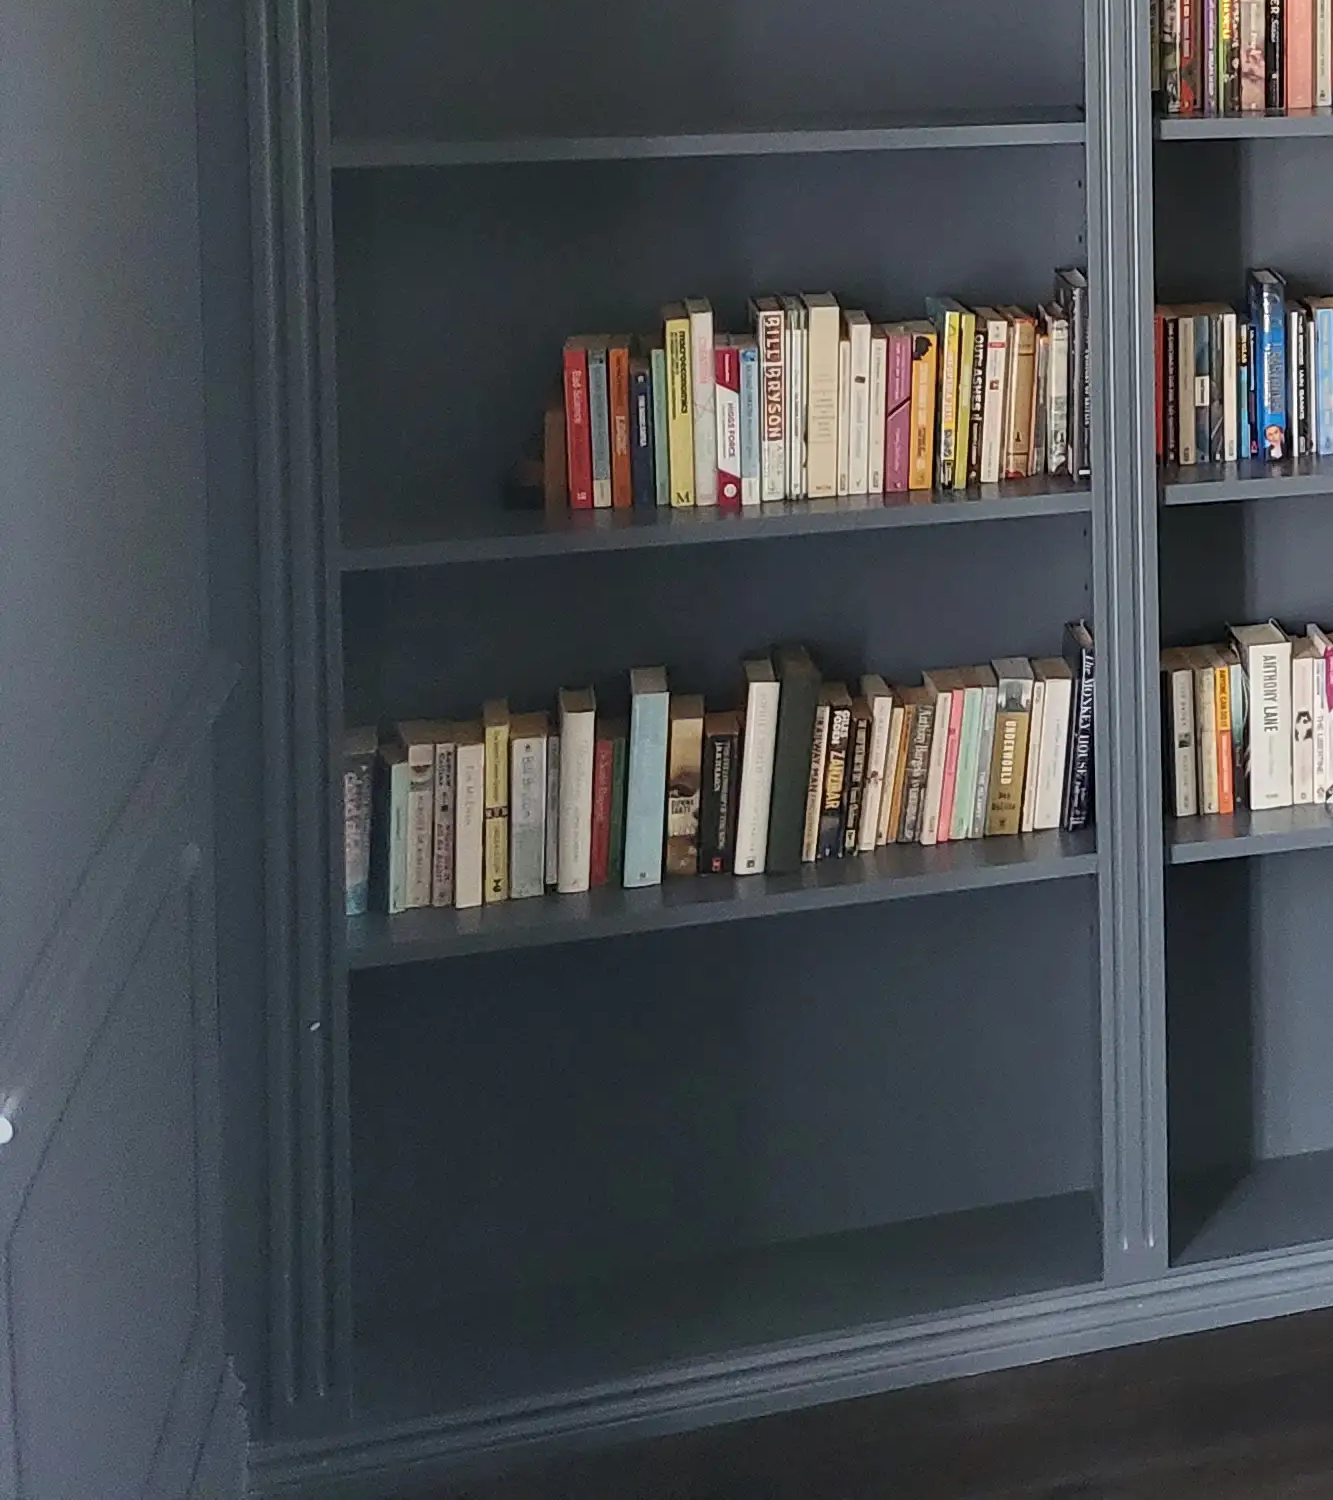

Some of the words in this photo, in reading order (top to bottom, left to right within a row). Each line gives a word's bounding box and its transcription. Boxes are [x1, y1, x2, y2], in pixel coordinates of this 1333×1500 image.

[765, 316, 780, 360] BILL
[975, 334, 984, 358] OUT
[680, 330, 688, 414] macroeconomics
[971, 368, 982, 411] ASHES
[766, 367, 782, 439] BRYSON
[728, 430, 736, 458] FORCE
[1084, 656, 1094, 676] The
[1263, 655, 1278, 702] ANTHONY
[1079, 678, 1094, 730] MONKEY
[1264, 706, 1278, 732] LANE
[1000, 720, 1017, 784] UNDERWORLD
[1076, 734, 1090, 778] HOUSE
[826, 750, 845, 810] ZANZIBAR
